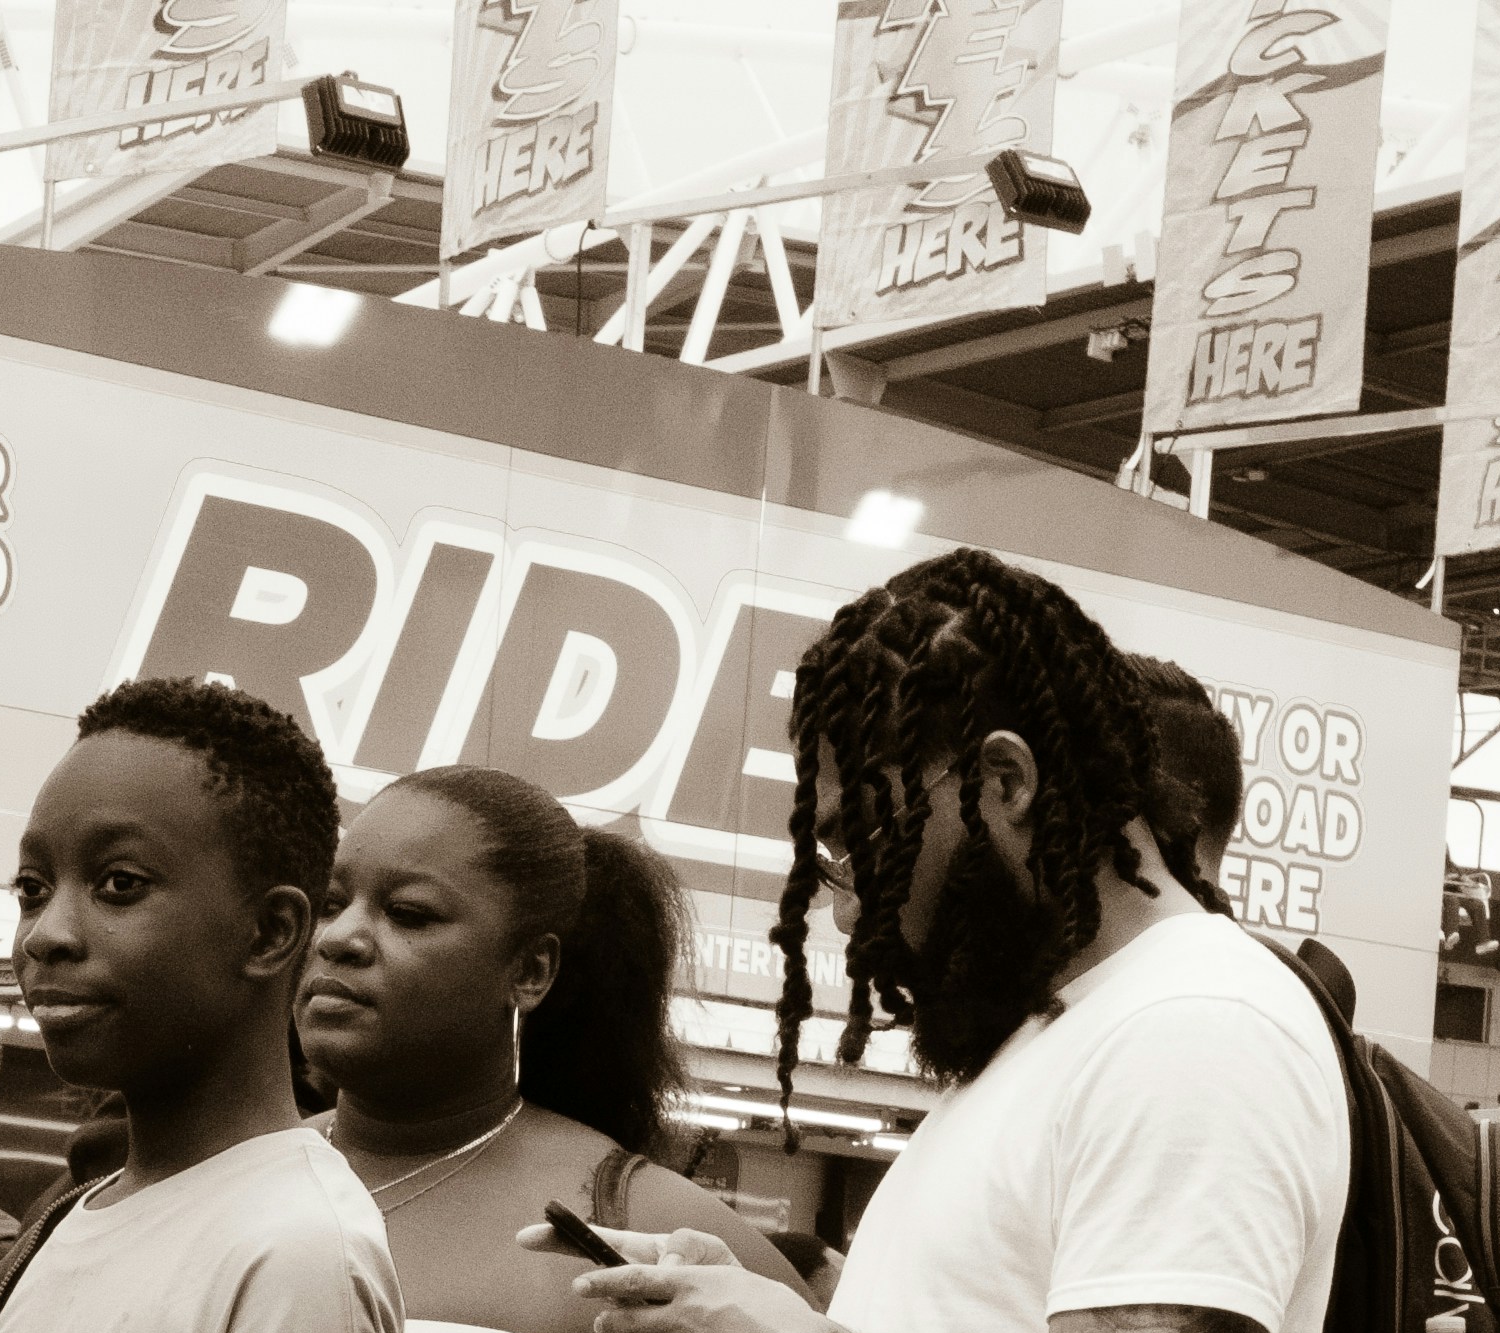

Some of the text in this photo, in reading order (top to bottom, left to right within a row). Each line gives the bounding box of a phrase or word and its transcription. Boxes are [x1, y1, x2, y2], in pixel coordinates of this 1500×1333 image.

[472, 101, 600, 218] HERE
[875, 202, 1025, 296] HERE
[1185, 315, 1323, 407] HERE
[1275, 704, 1366, 786] OR
